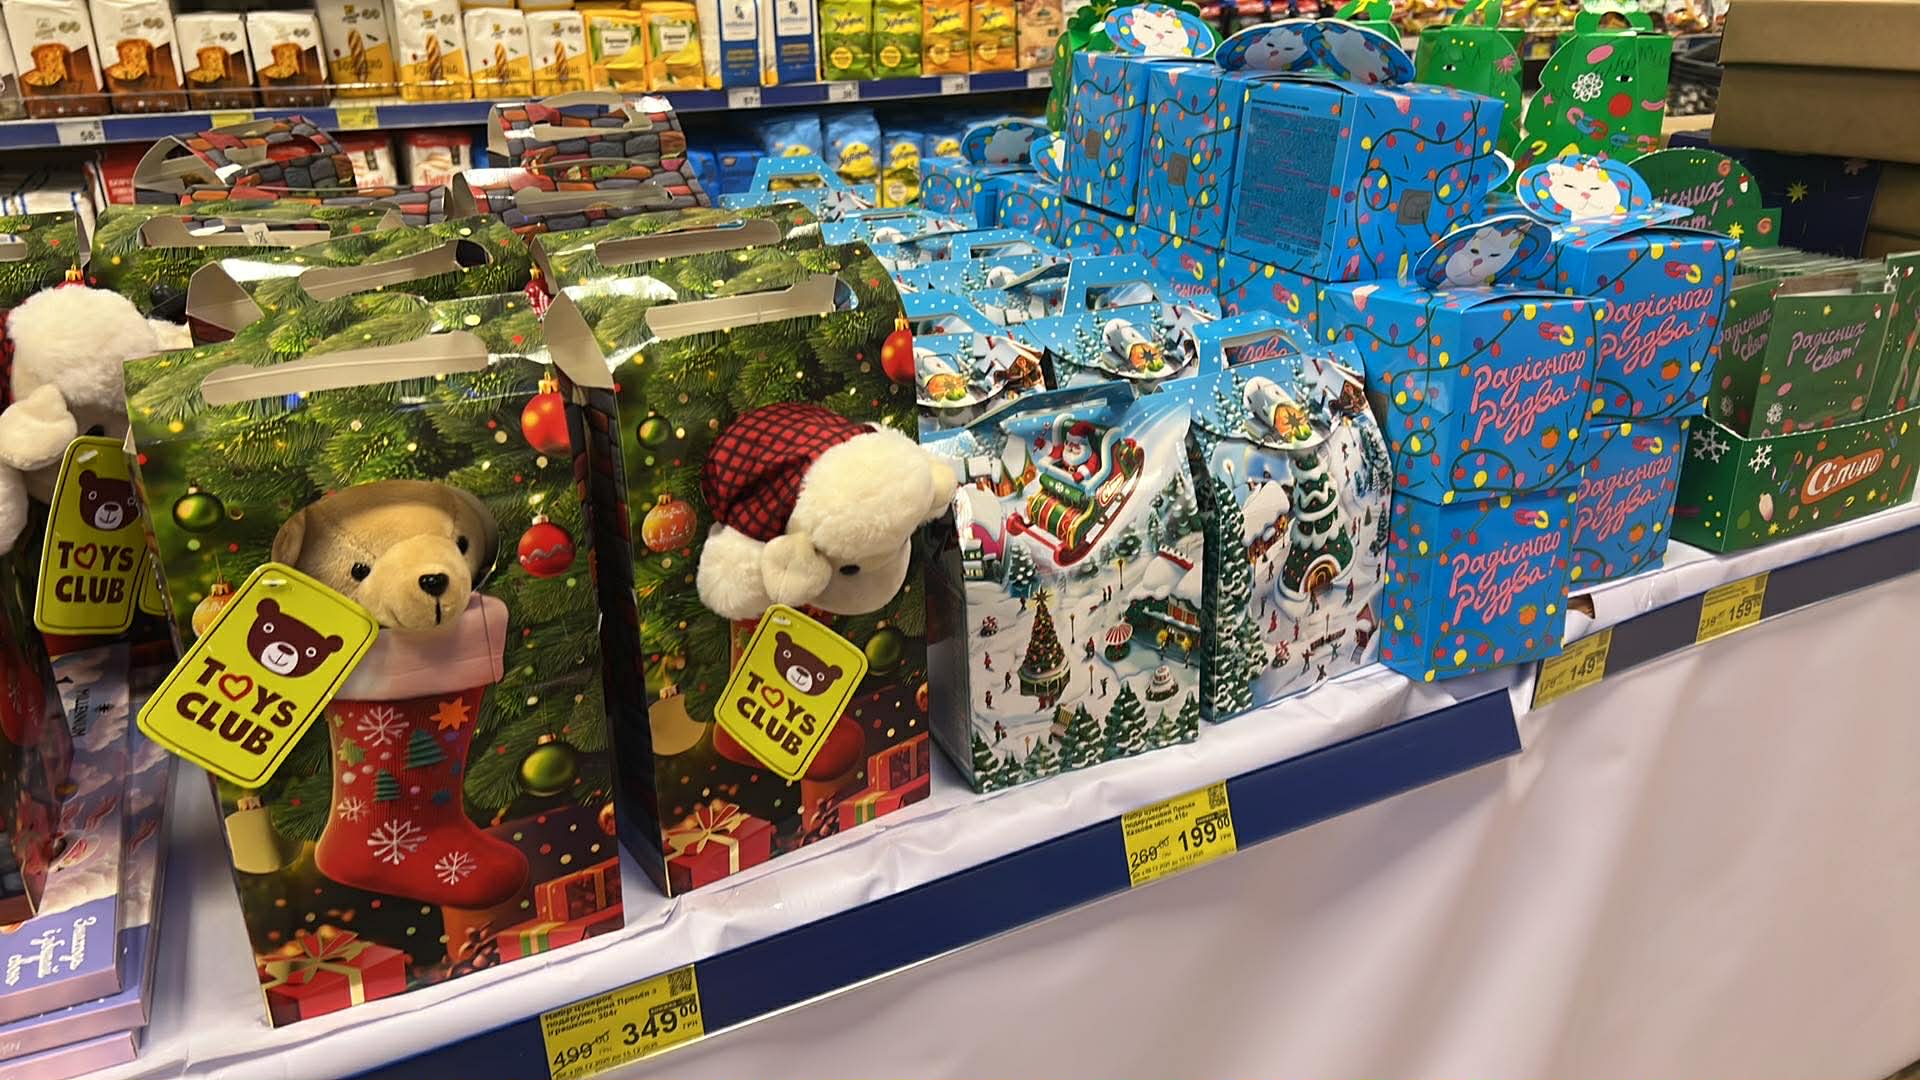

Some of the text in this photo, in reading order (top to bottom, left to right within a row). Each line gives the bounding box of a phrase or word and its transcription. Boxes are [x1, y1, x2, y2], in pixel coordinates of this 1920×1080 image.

[1471, 350, 1586, 415] Радісного
[1473, 375, 1580, 445] Різдва!
[1807, 454, 1880, 496] Сільпо
[1572, 476, 1666, 545] Різдва!
[1449, 531, 1560, 599] Радісного
[55, 575, 125, 603] CLUB
[1453, 555, 1556, 626] Різдва!
[1729, 600, 1752, 622] 159
[1571, 656, 1596, 680] 149
[176, 691, 276, 756] CLUB
[736, 696, 803, 757] CLUB
[1130, 846, 1158, 869] 269
[1178, 822, 1217, 851] 199
[622, 1009, 678, 1046] 349
[680, 1002, 698, 1018] 00
[553, 1042, 593, 1069] 499
